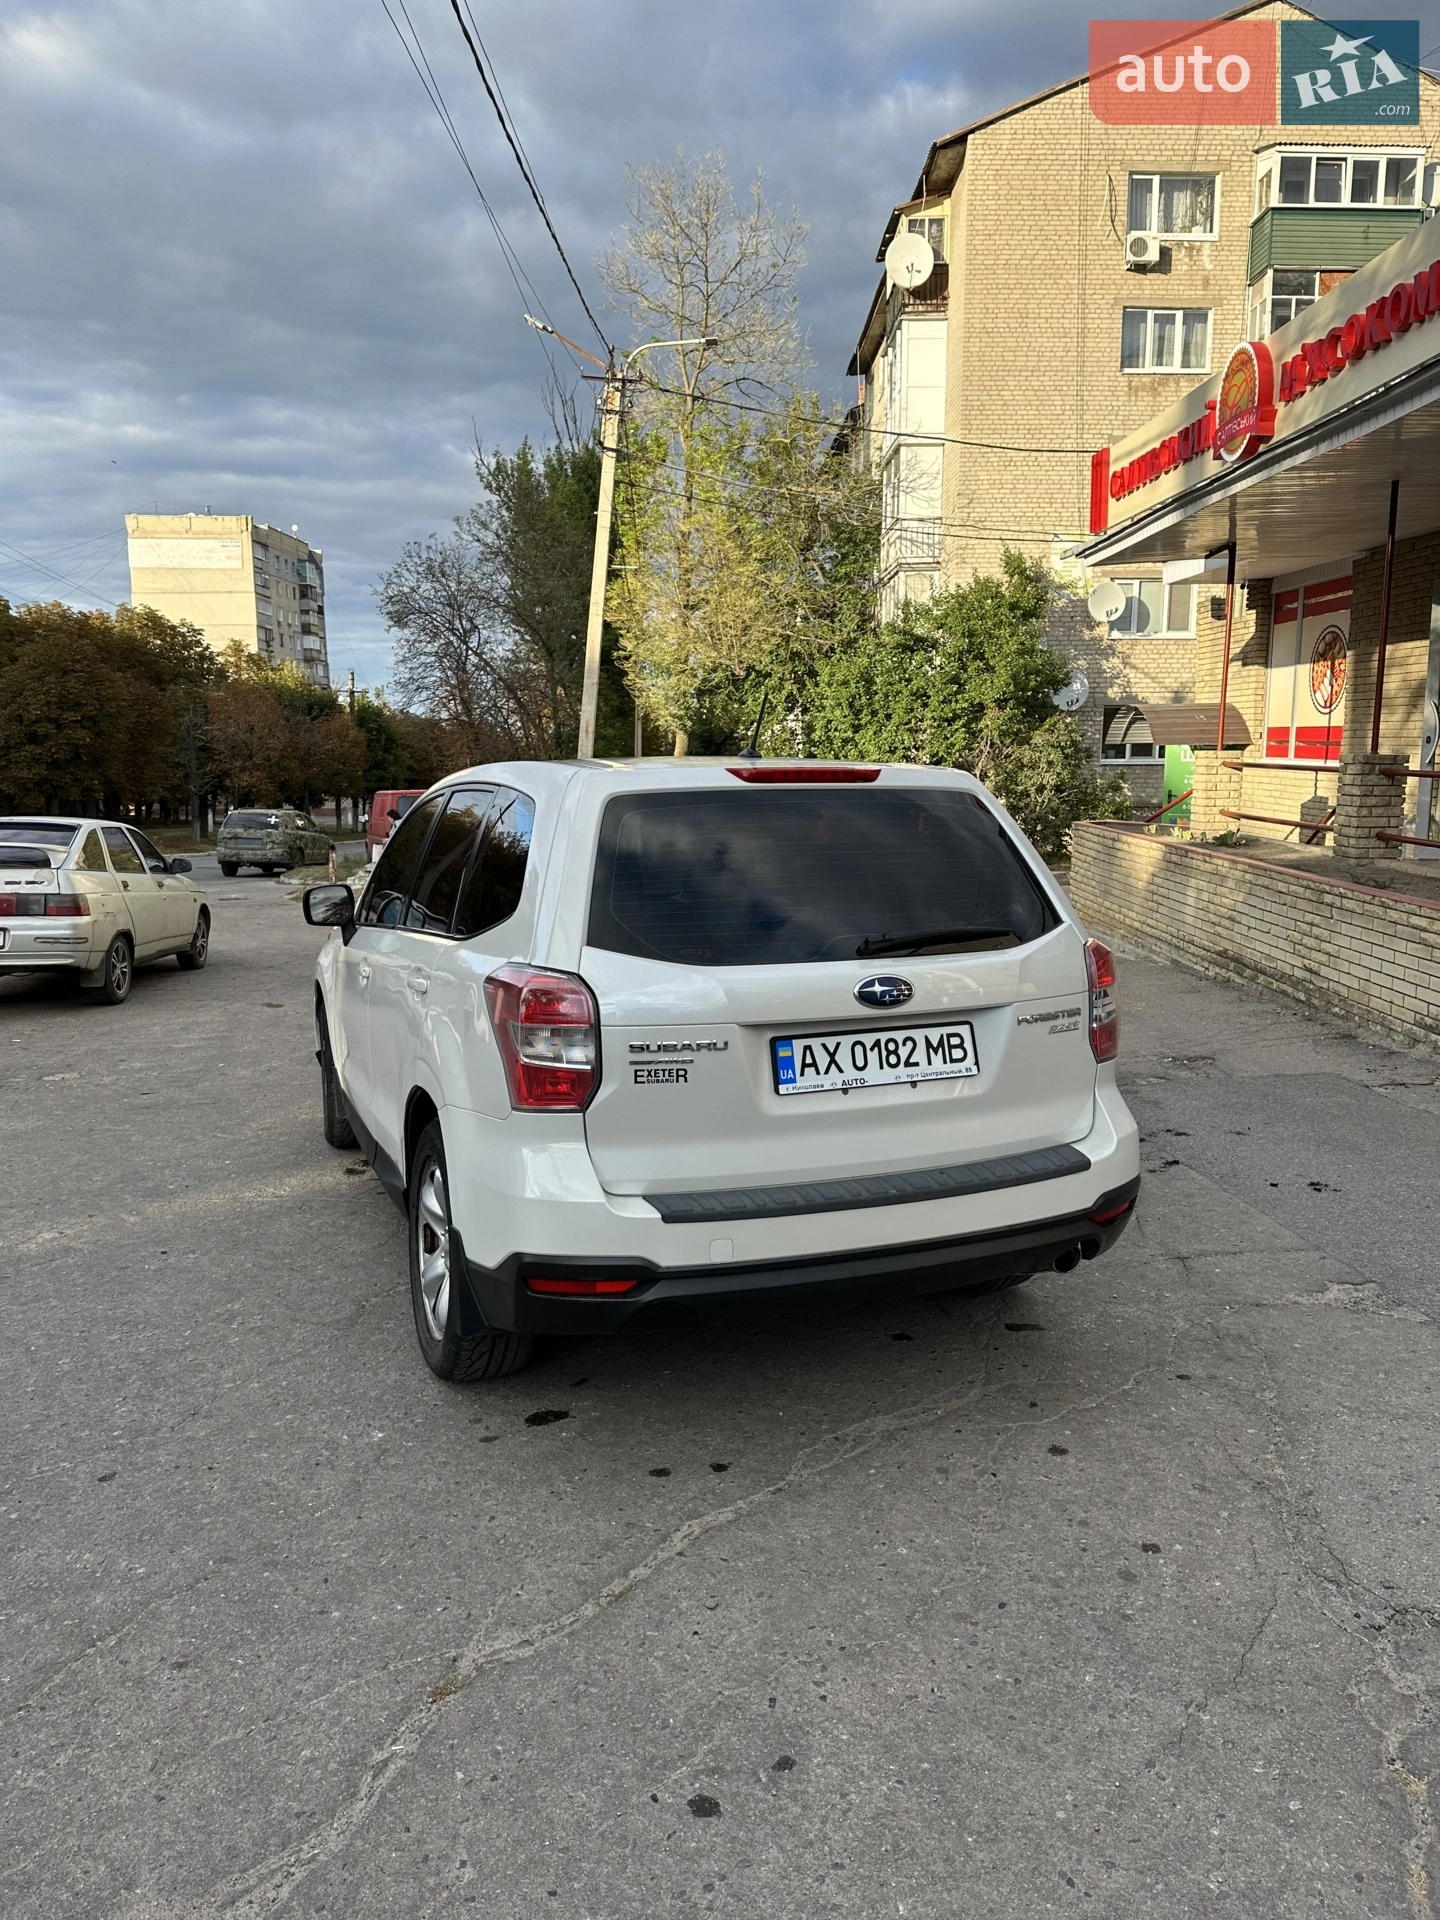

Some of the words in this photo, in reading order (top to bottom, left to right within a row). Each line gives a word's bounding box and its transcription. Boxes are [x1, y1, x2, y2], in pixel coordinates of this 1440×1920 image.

[1017, 1007, 1082, 1026] FORESTER
[629, 1040, 729, 1053] SUBARU
[654, 1057, 695, 1065] AWD
[799, 1041, 845, 1077] AX
[850, 1035, 920, 1073] 0182
[924, 1032, 968, 1066] MB
[633, 1067, 688, 1084] EXETER
[780, 1069, 794, 1079] UA
